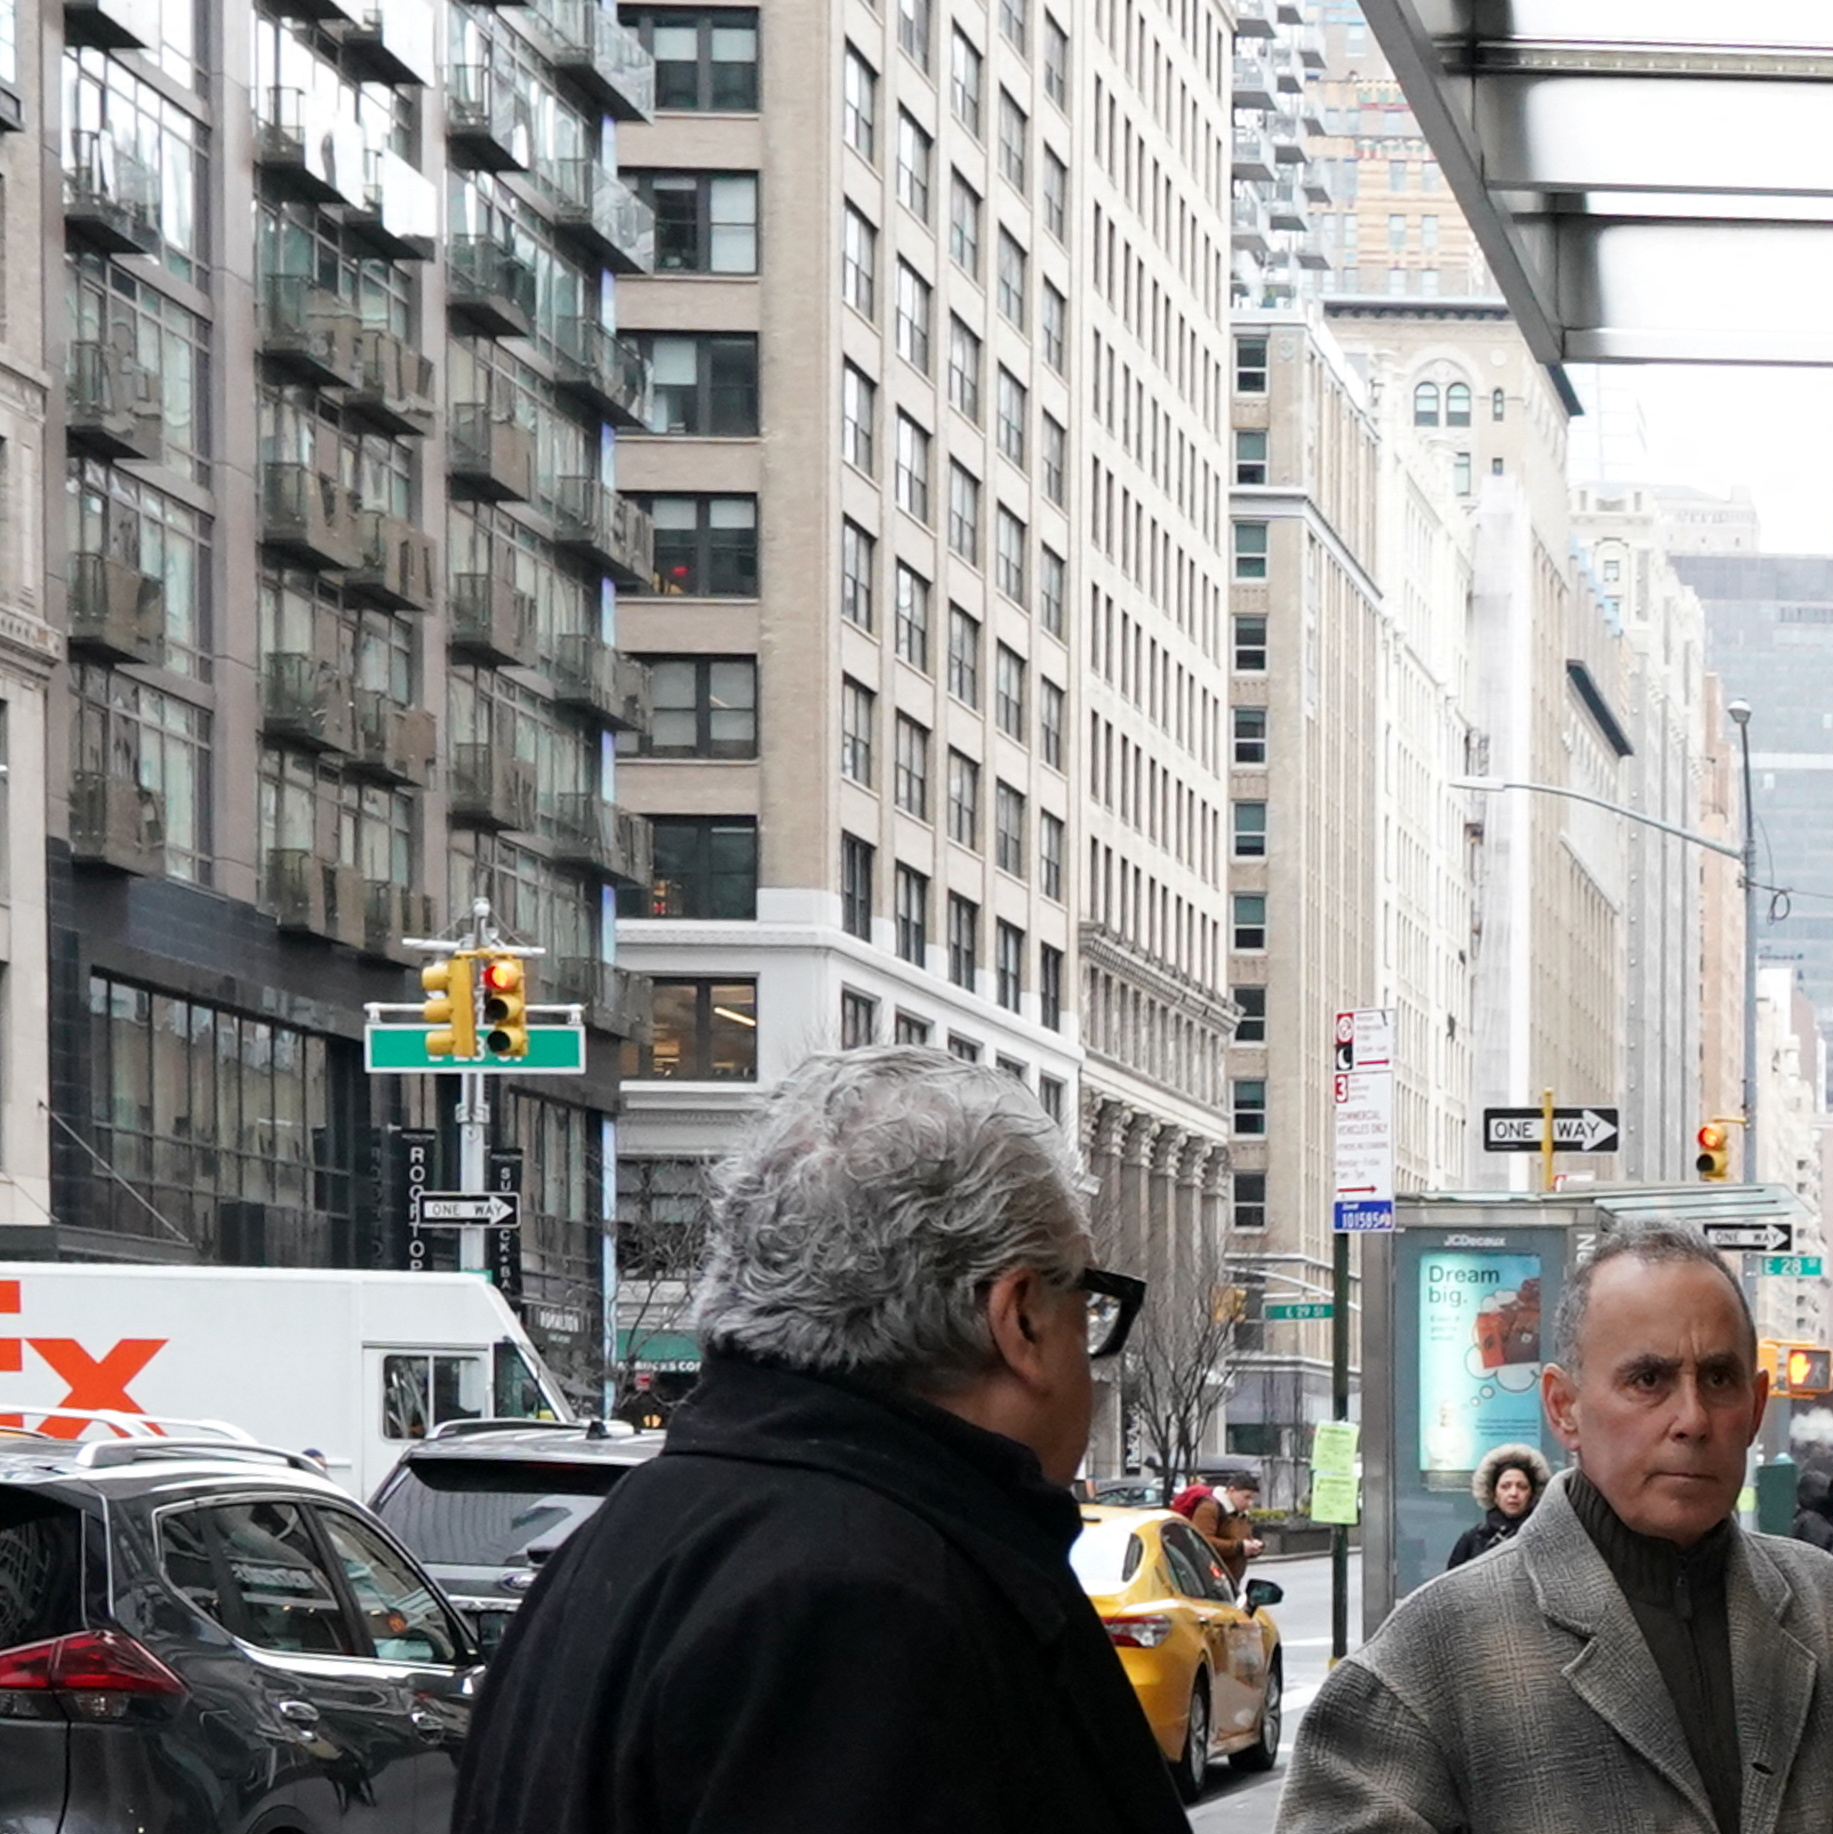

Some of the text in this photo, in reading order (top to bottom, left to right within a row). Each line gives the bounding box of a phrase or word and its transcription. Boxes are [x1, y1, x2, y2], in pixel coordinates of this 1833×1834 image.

[1494, 1121, 1600, 1139] ONE WAY
[432, 1203, 503, 1216] ONE WAY
[1443, 1234, 1505, 1247] JCDecaux
[1715, 1231, 1779, 1242] ONE WAY
[1428, 1265, 1500, 1284] Dream
[1764, 1259, 1775, 1274] E
[1781, 1259, 1802, 1275] 28
[1428, 1287, 1468, 1307] big.
